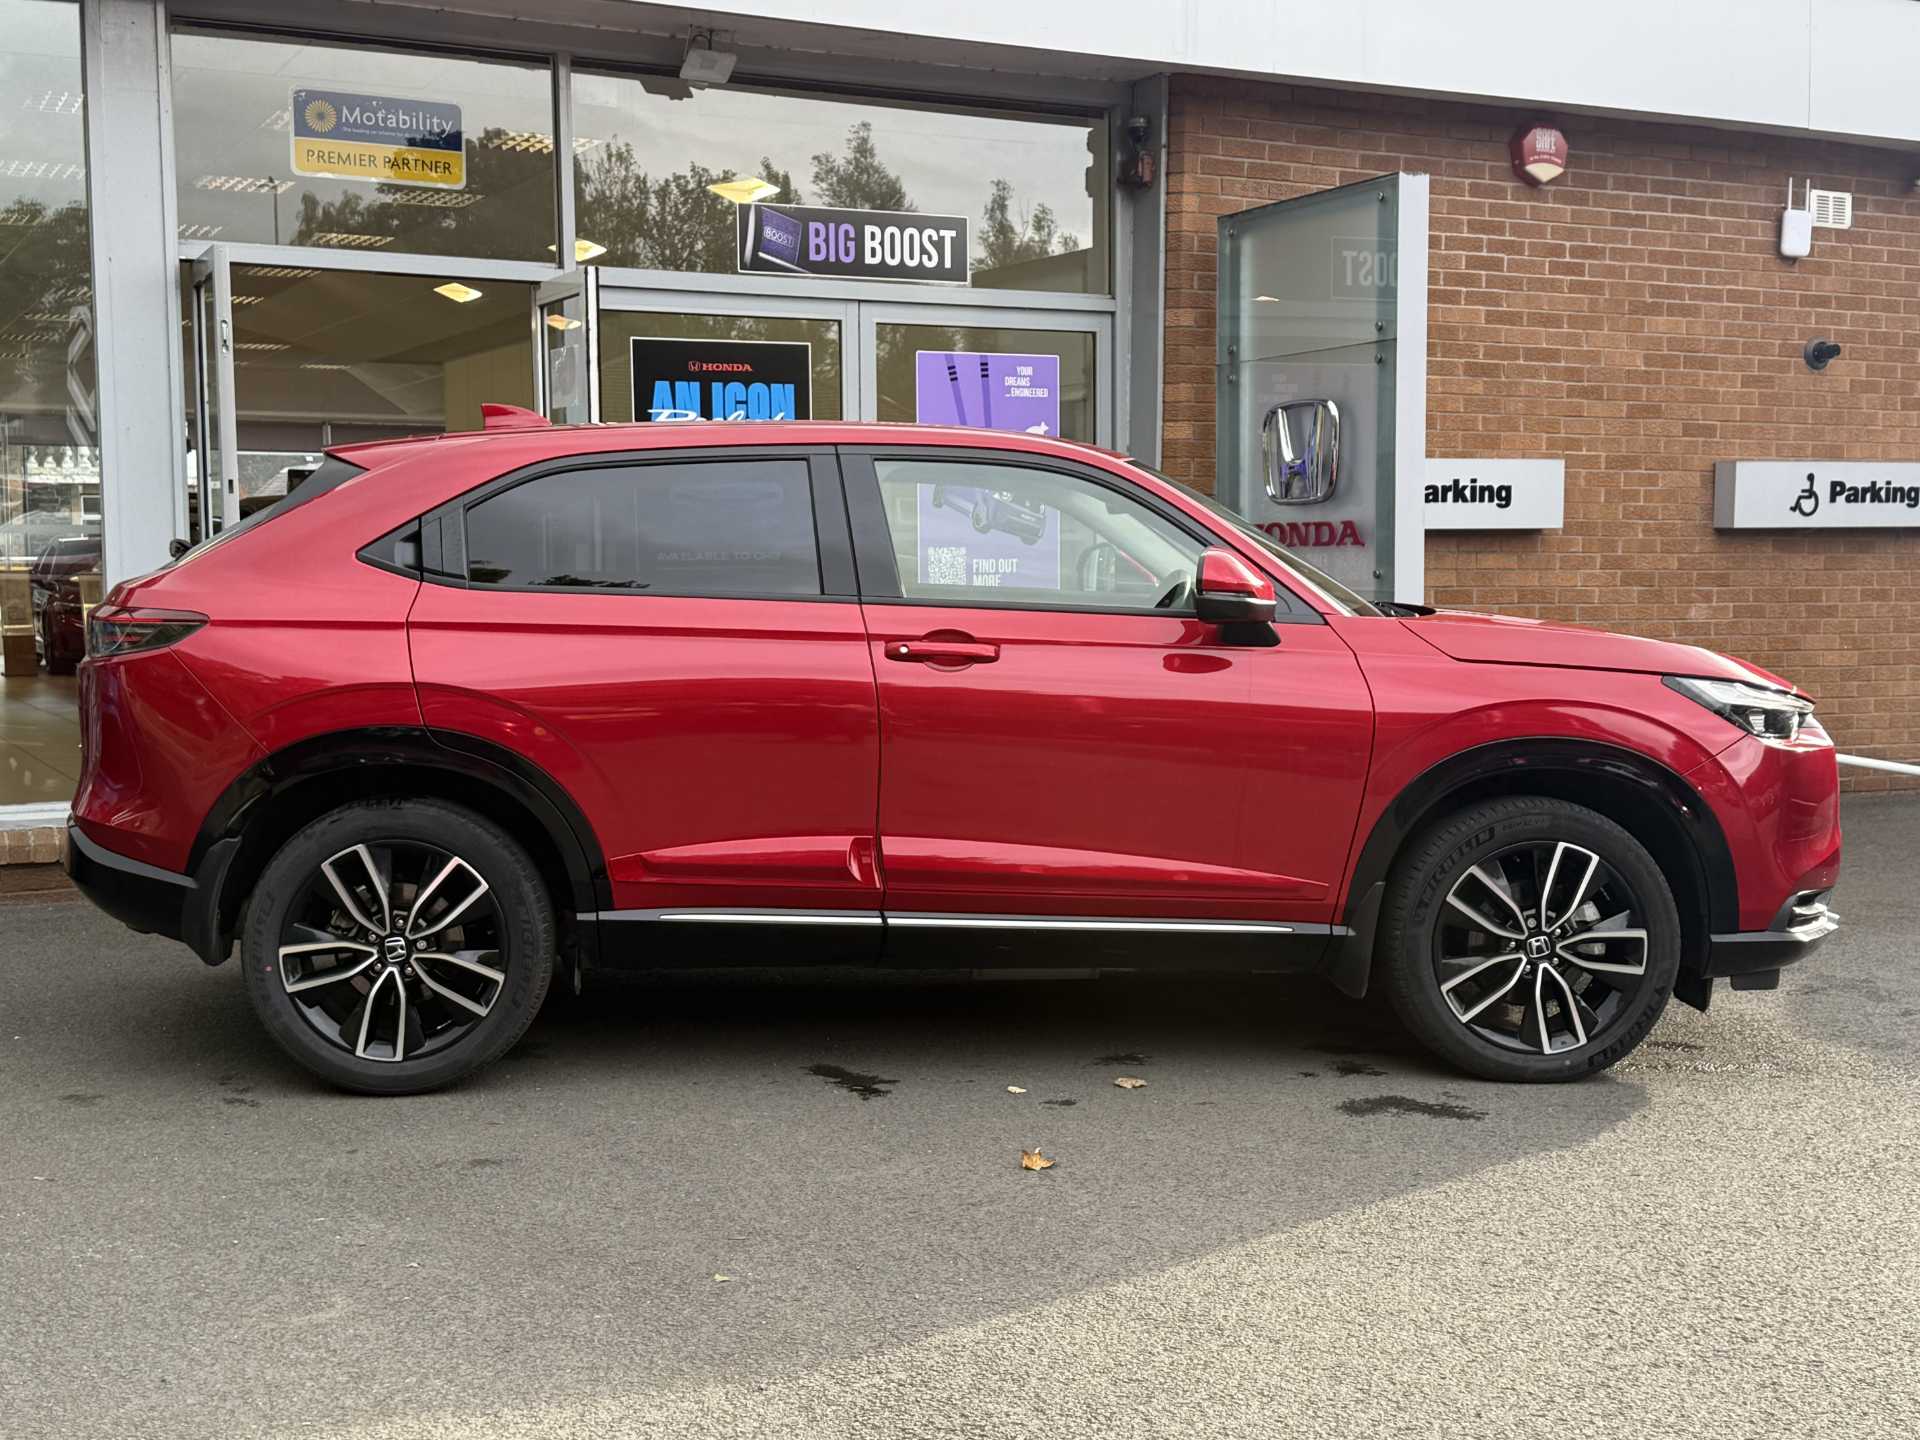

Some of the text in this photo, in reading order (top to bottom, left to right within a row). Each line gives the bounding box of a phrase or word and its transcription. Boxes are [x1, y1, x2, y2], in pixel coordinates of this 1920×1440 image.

[342, 106, 453, 137] Motability
[306, 150, 453, 175] PREMIER PARTNER
[765, 226, 793, 246] BOOST
[808, 222, 957, 269] BIG BOOST
[702, 363, 753, 372] HONDA
[1016, 366, 1033, 376] YOUR
[1004, 376, 1031, 386] DREAMS
[651, 380, 795, 421] AN ICON
[1424, 478, 1512, 508] arking
[1829, 480, 1920, 508] Parking
[1254, 520, 1365, 547] ONDA
[973, 558, 1018, 573] FIND OUT
[973, 574, 1001, 587] MORE
